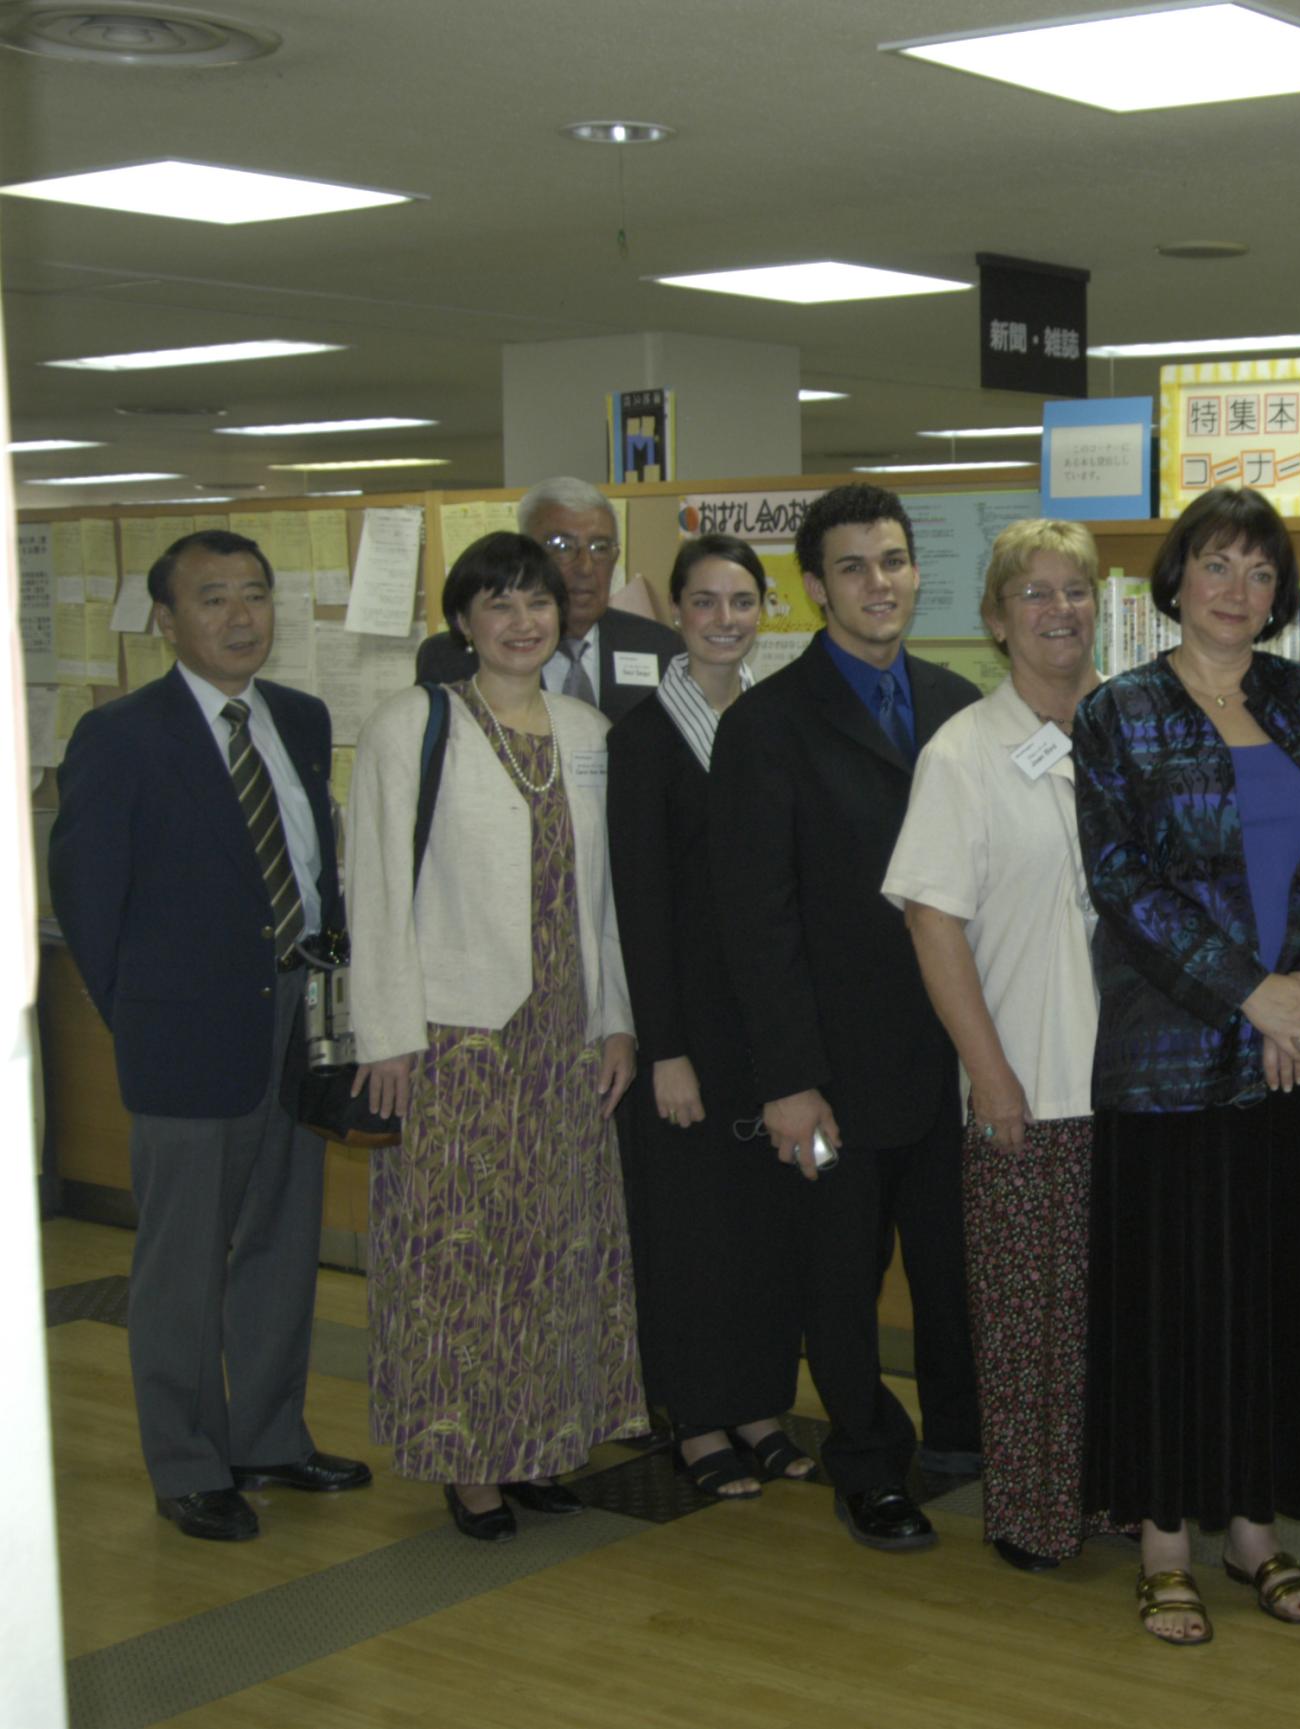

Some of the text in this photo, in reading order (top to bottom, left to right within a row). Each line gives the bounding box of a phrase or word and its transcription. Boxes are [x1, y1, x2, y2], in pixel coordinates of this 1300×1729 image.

[990, 319, 1080, 361] 新聞・雑誌
[1191, 397, 1296, 432] 特集本
[1185, 452, 1300, 485] コーナー
